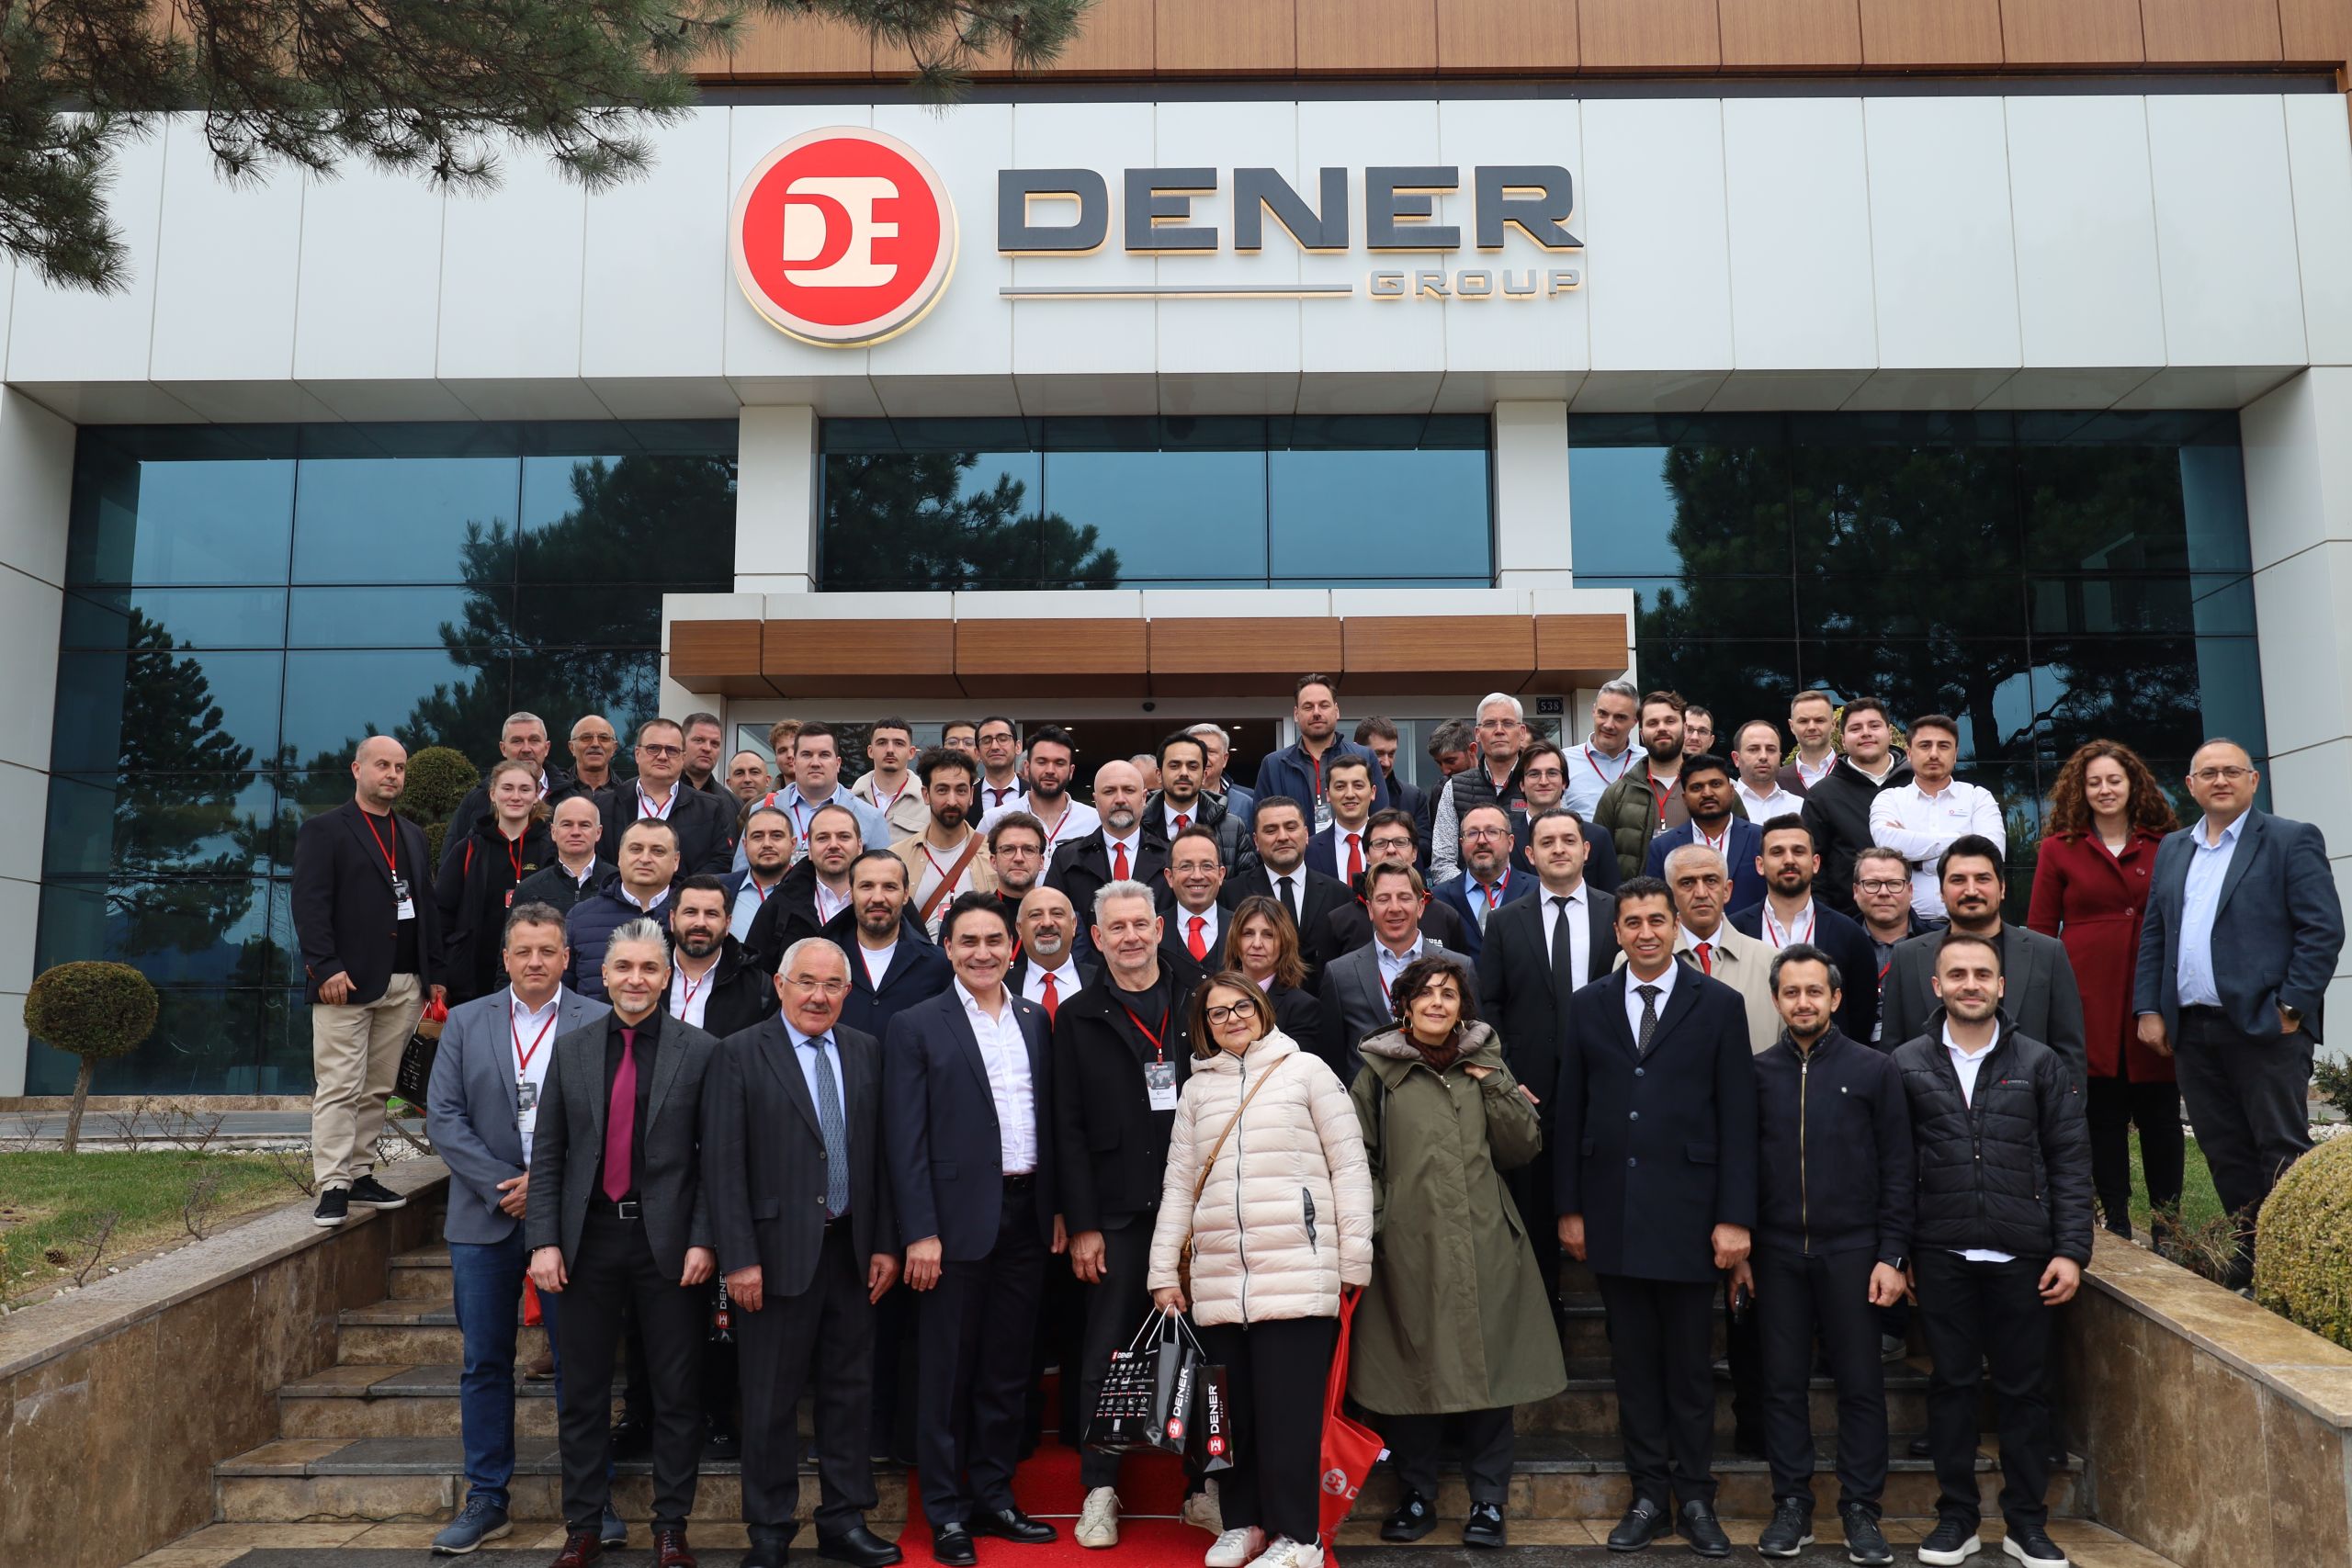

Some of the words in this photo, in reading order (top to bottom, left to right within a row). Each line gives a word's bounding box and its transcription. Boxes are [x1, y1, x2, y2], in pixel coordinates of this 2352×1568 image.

[998, 165, 1585, 253] DENER
[1370, 269, 1580, 296] GROUP
[1541, 701, 1559, 711] 538
[1172, 1367, 1189, 1416] DENER
[1208, 1384, 1220, 1435] DENER
